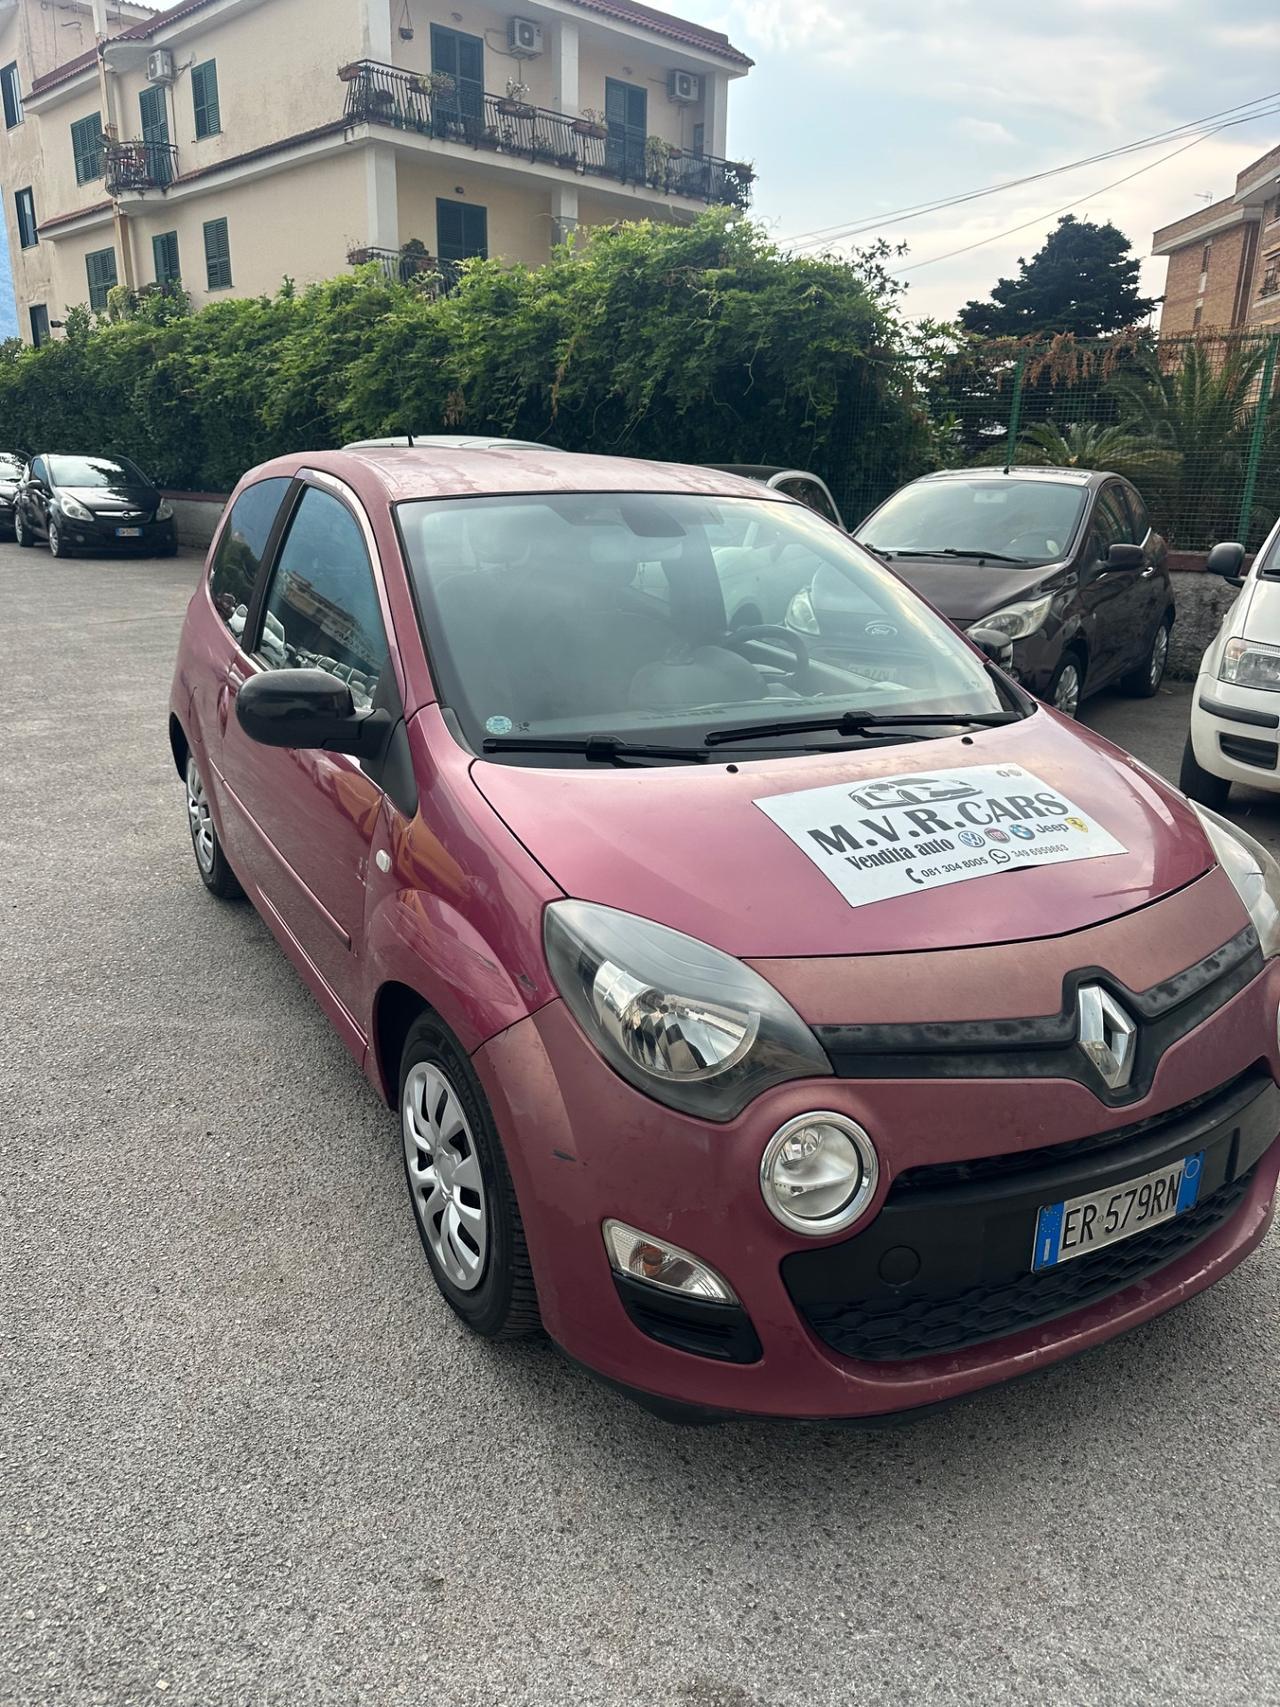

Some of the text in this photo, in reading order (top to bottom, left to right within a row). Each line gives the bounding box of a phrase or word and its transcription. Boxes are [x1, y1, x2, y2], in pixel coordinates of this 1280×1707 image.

[807, 792, 1069, 855] M.V.R.CARS
[1036, 823, 1069, 834] Jeep
[845, 838, 955, 870] Vendita auto
[921, 857, 988, 878] 081 304 8005
[1062, 1171, 1182, 1249] ER 579RN
